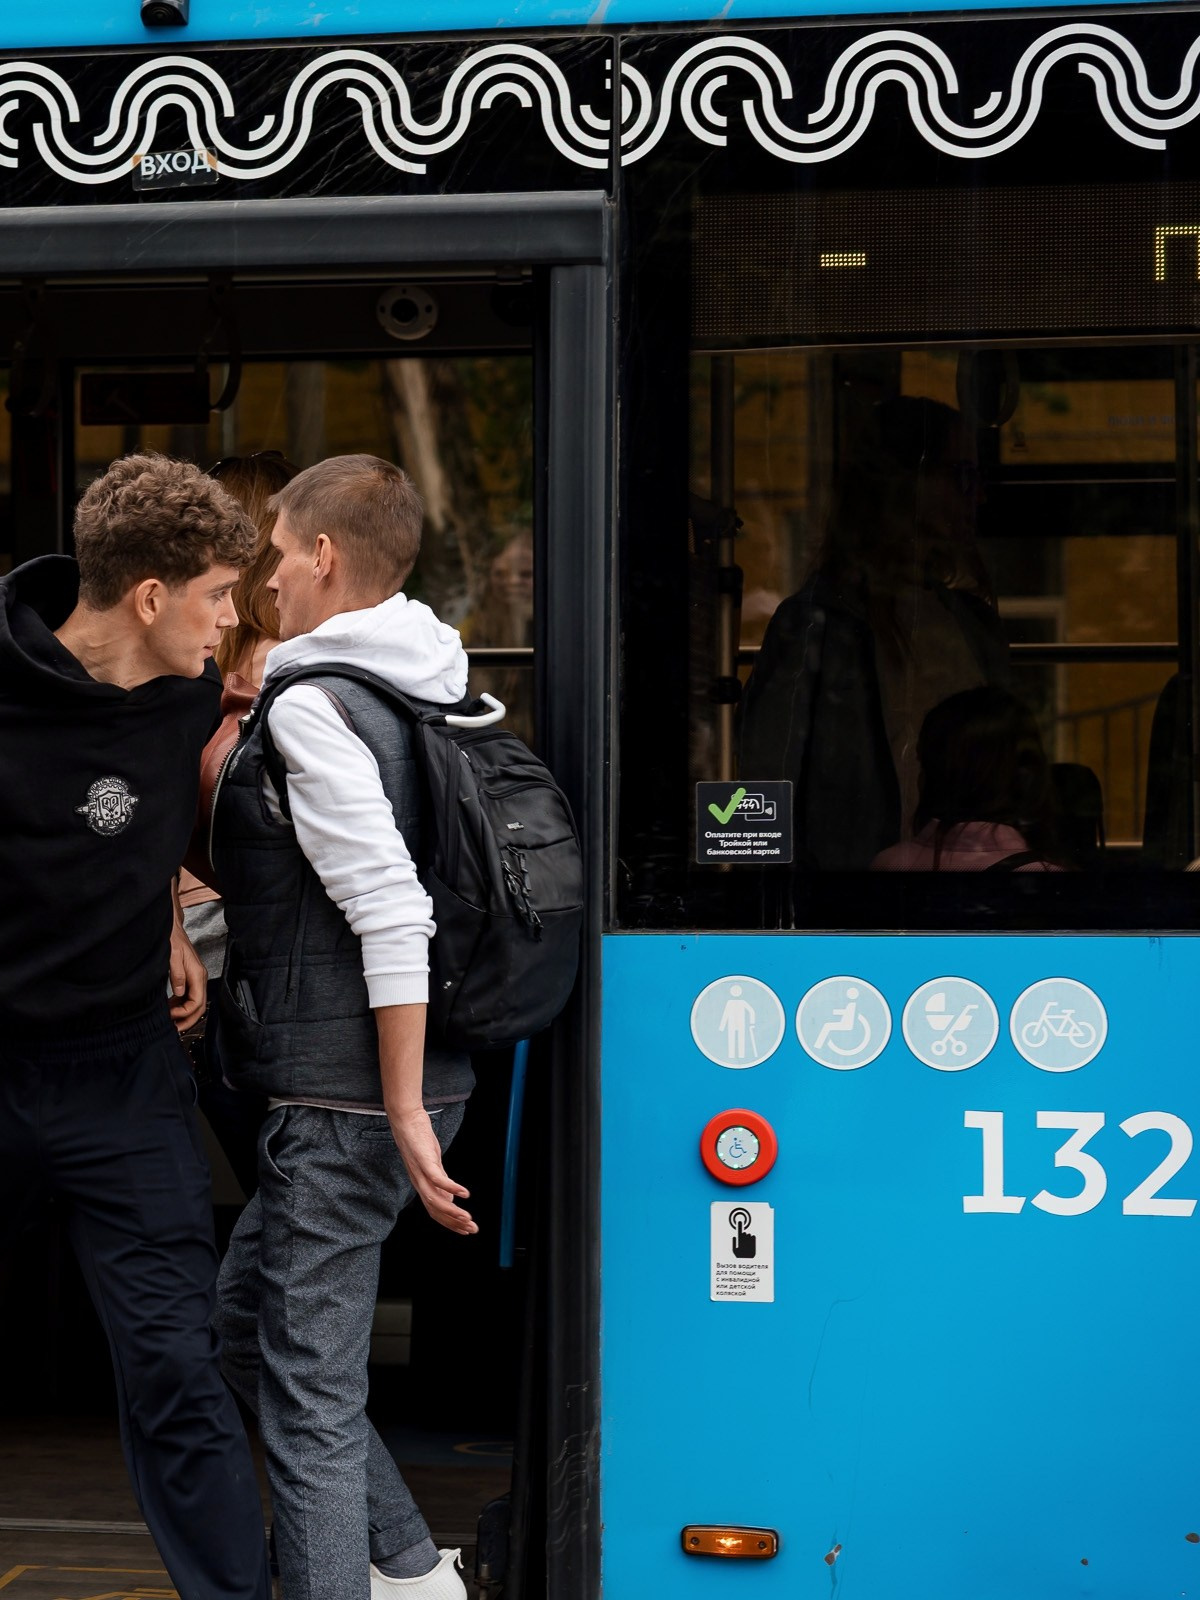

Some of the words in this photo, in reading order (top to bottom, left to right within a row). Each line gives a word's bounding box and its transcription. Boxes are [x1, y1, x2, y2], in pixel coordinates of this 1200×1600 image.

[140, 150, 212, 176] ВХОД
[705, 831, 742, 839] Оплатите
[719, 840, 752, 848] Тройкой
[707, 848, 752, 856] банковской
[753, 848, 780, 856] картой
[963, 1110, 1198, 1216] 132
